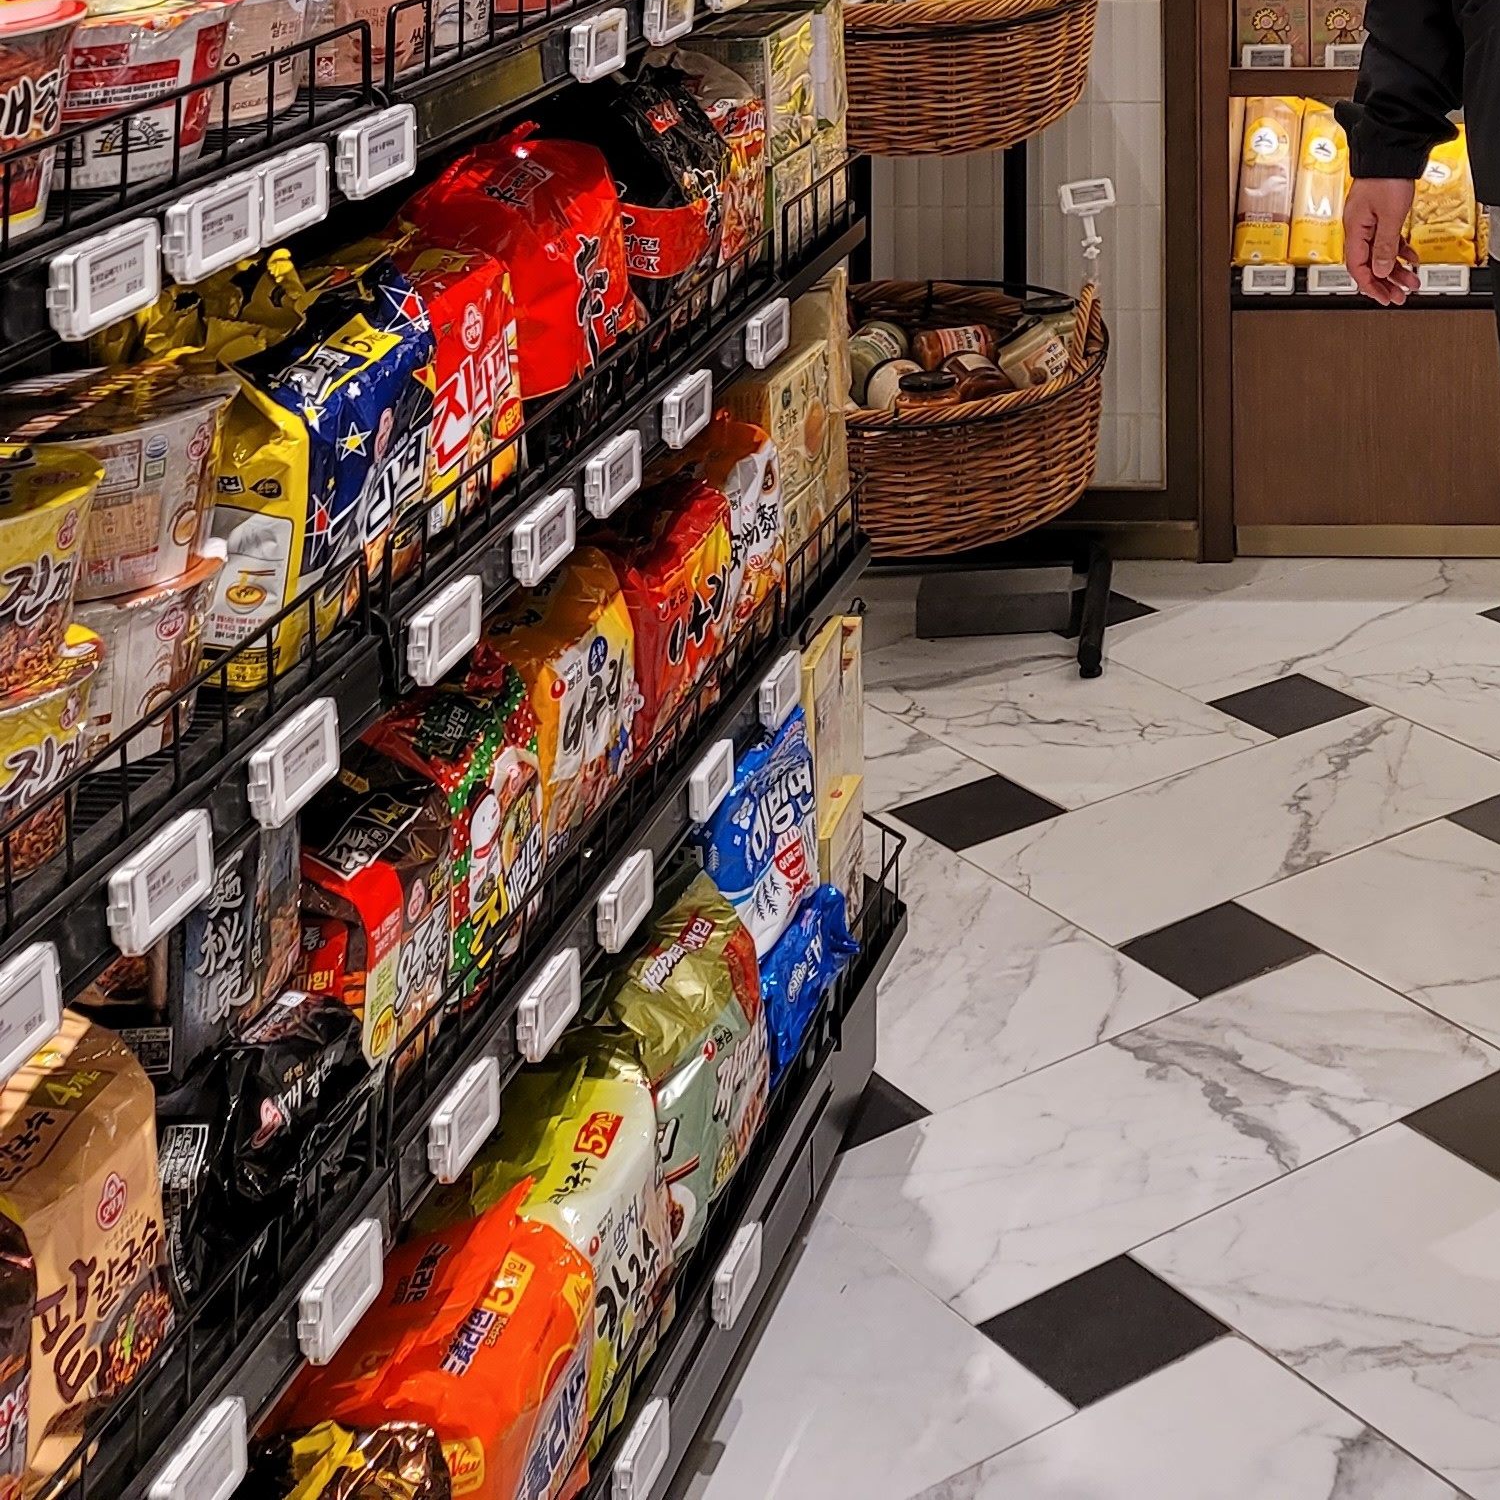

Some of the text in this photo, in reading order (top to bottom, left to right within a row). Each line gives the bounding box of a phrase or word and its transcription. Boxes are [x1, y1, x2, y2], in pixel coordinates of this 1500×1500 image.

[561, 646, 625, 757] 너구리
[614, 1199, 639, 1259] 멸치
[447, 1448, 481, 1481] New
